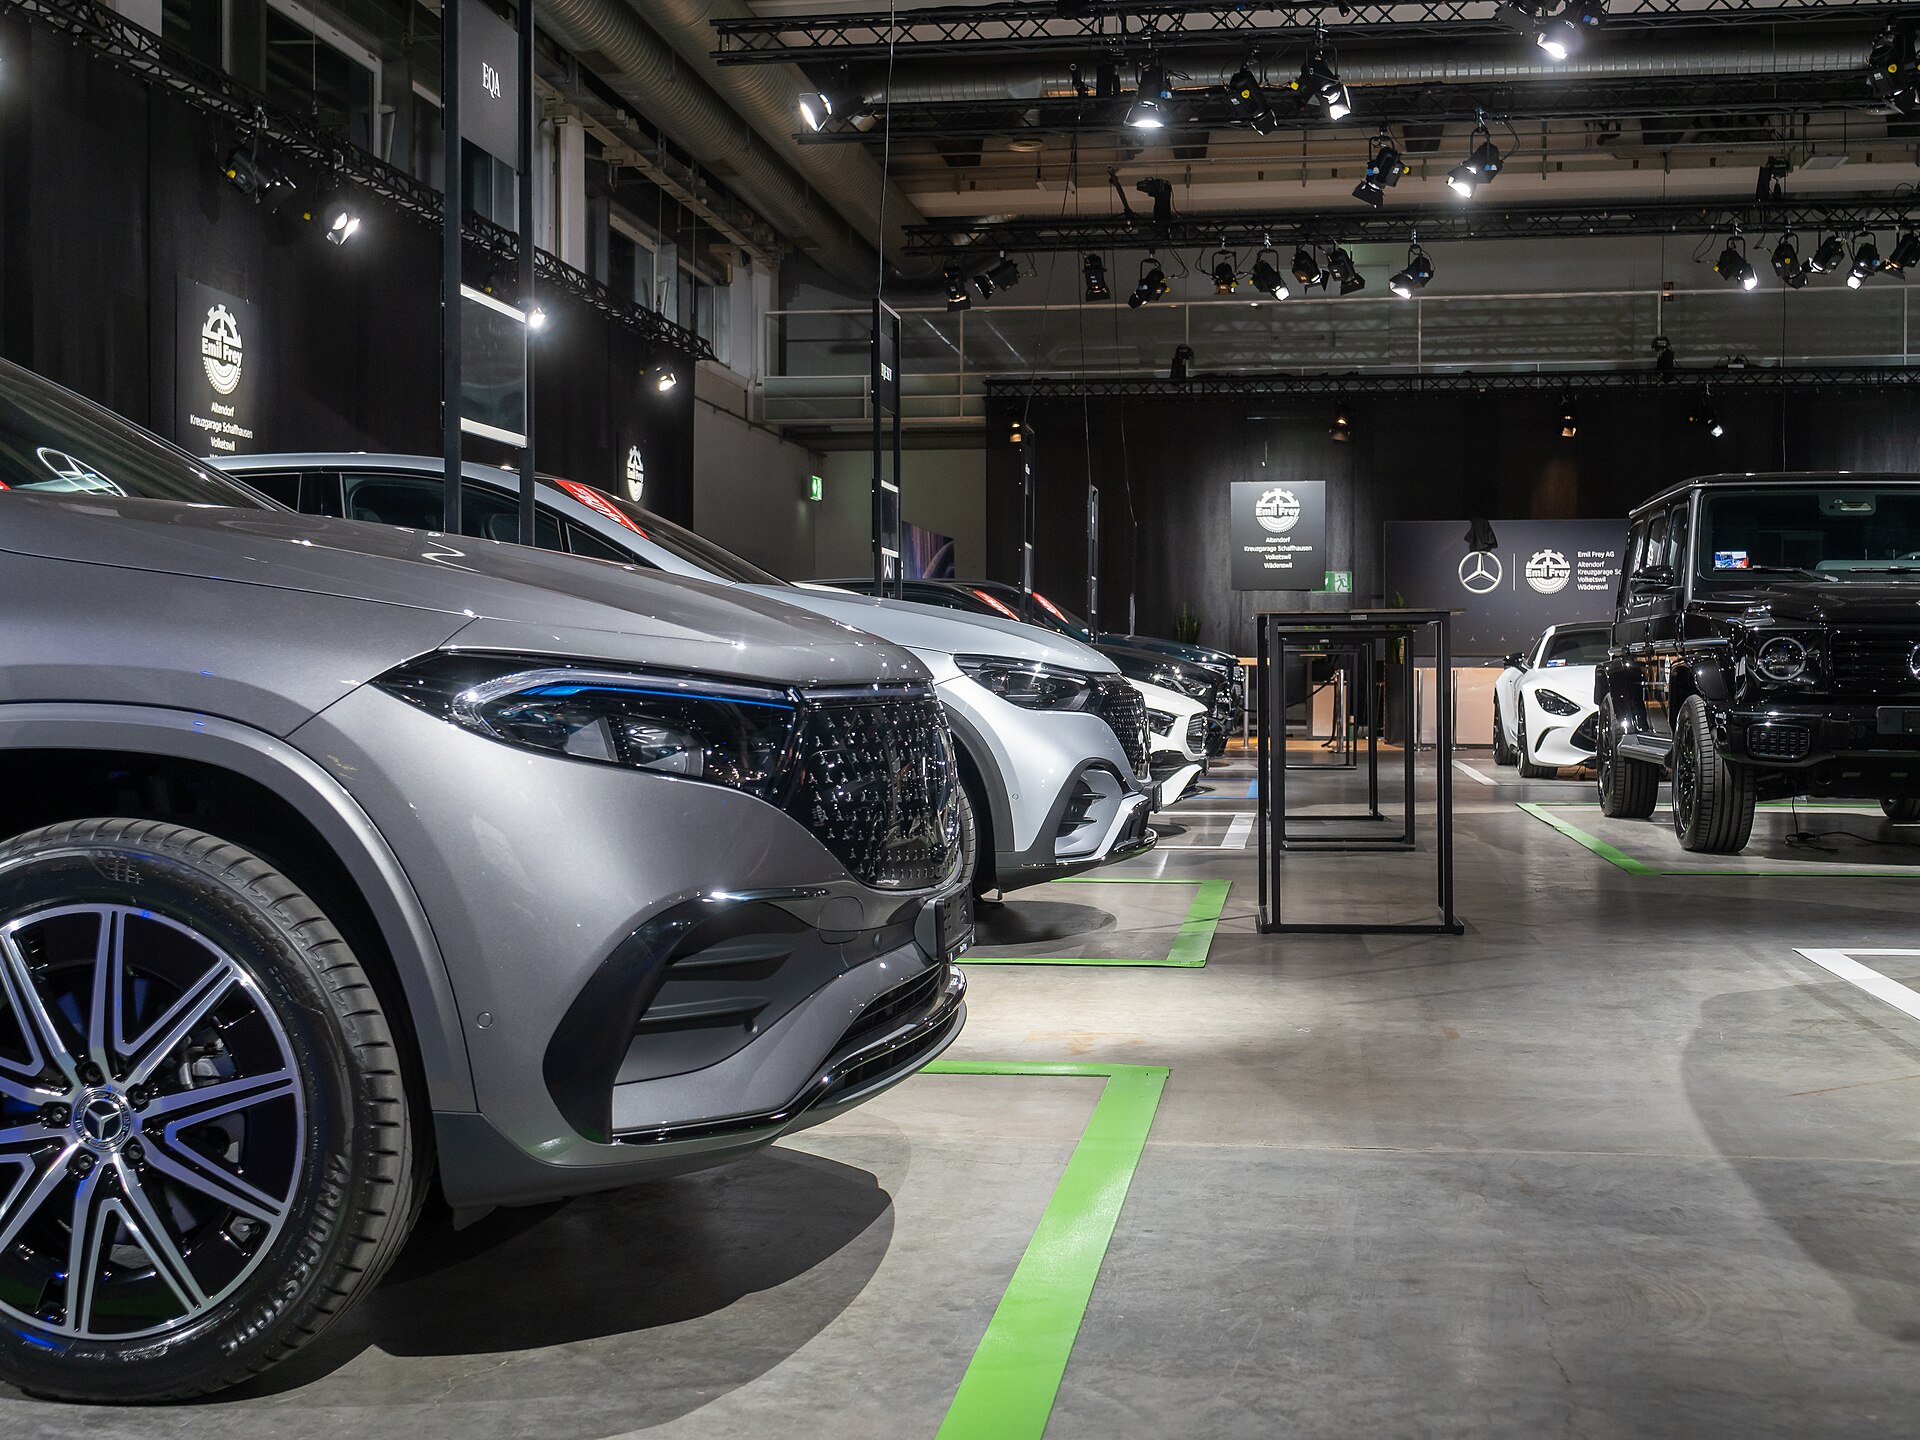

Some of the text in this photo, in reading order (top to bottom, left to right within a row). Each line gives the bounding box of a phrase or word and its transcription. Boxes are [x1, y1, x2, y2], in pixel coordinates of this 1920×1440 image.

[482, 62, 501, 99] EQA
[201, 340, 243, 367] Emil Frey
[211, 401, 235, 418] Altendorf
[1255, 506, 1301, 518] Emil Frey
[1592, 551, 1605, 559] Frey
[1525, 567, 1571, 579] Emil Frey
[1577, 569, 1614, 577] Kreuzgarage
